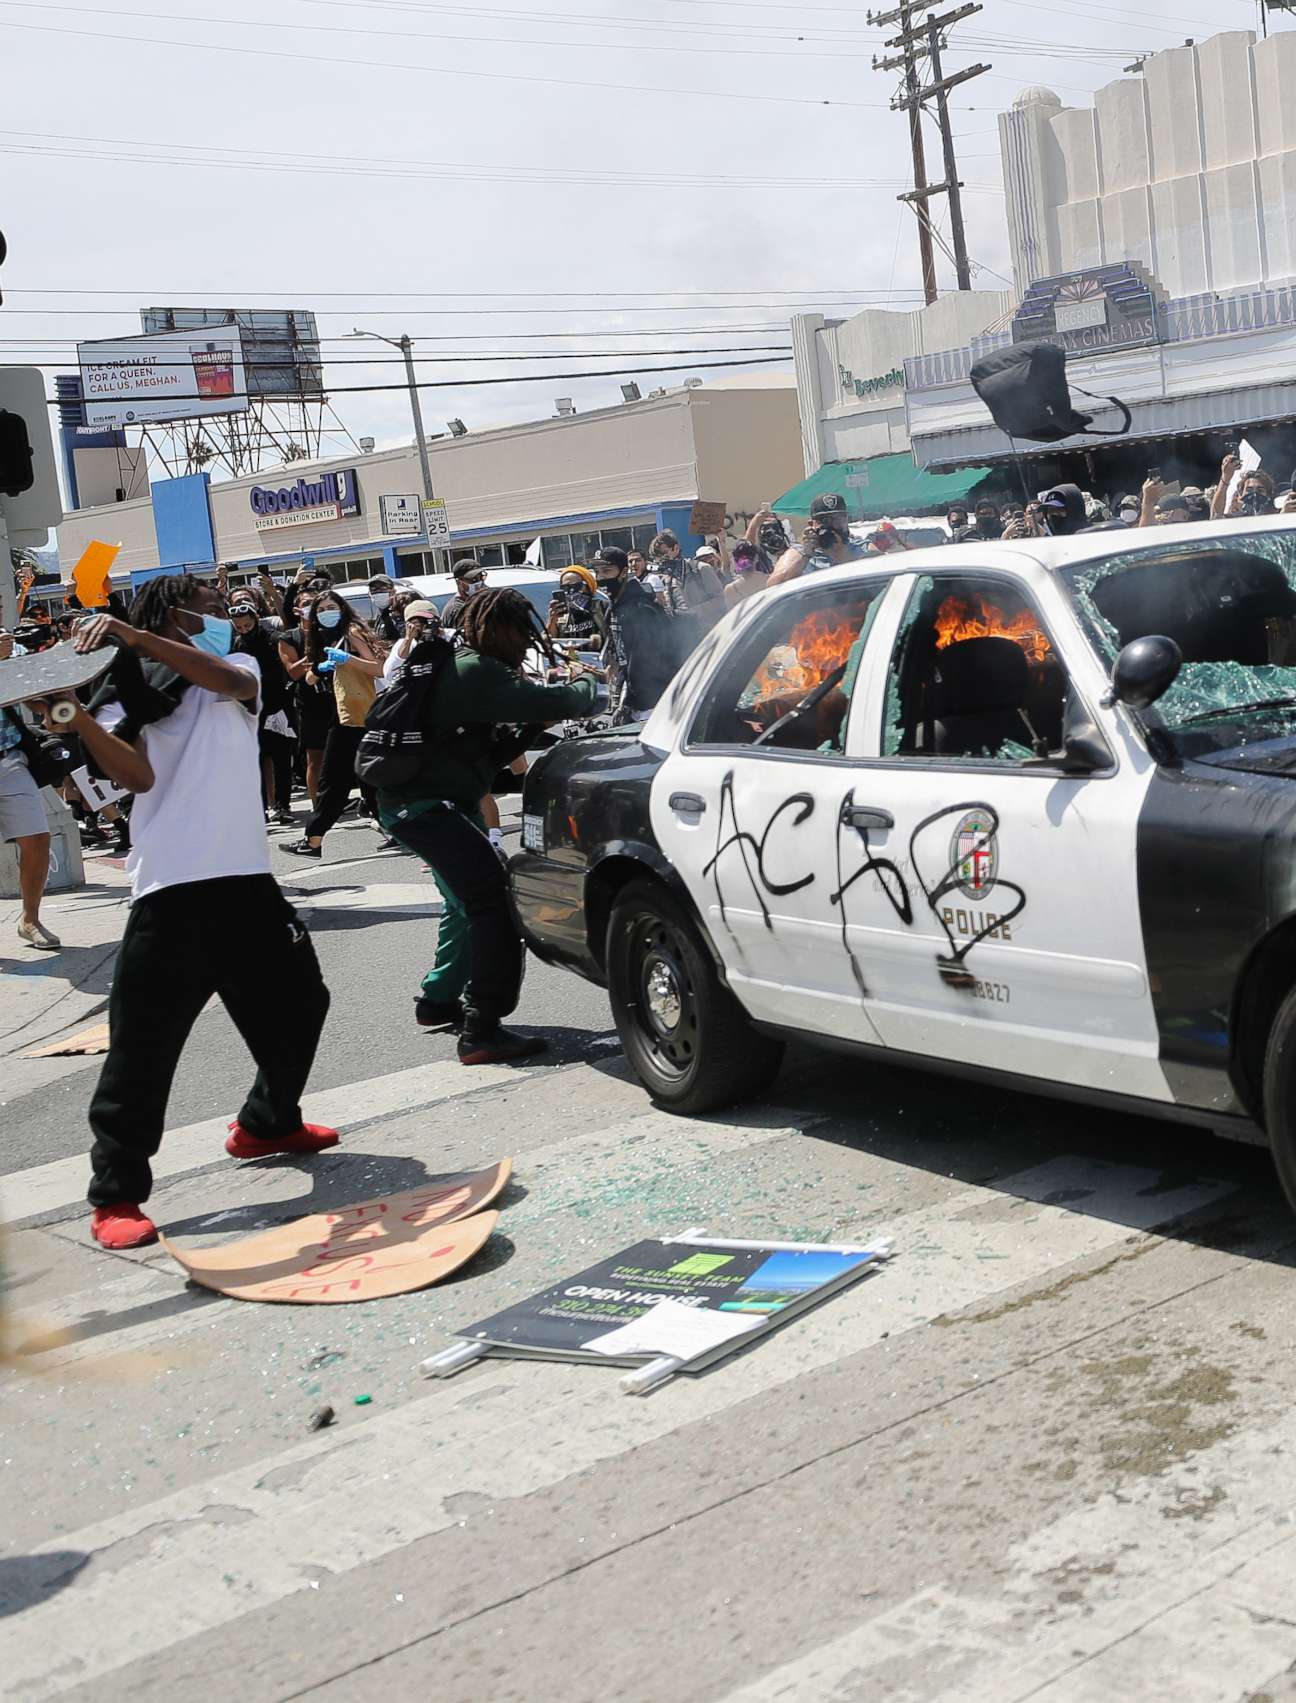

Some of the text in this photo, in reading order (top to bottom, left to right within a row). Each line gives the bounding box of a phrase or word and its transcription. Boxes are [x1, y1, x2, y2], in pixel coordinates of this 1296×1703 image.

[1082, 318, 1153, 347] CINEMAS
[142, 356, 158, 366] FIT
[88, 368, 156, 383] FOR A QUEEN.
[89, 383, 115, 393] CALL
[135, 375, 181, 389] MEGHAN.
[250, 473, 337, 514] Goodwill
[255, 519, 274, 529] STORE
[281, 514, 310, 525] DONATION
[311, 509, 335, 520] CENTER
[428, 522, 447, 535] 25
[703, 769, 1026, 963] ACAB
[943, 907, 1012, 941] POLICE
[613, 1265, 746, 1283] THE SUNSET TEAM
[563, 1285, 632, 1303] OPEN
[624, 1291, 711, 1308] HOUSE
